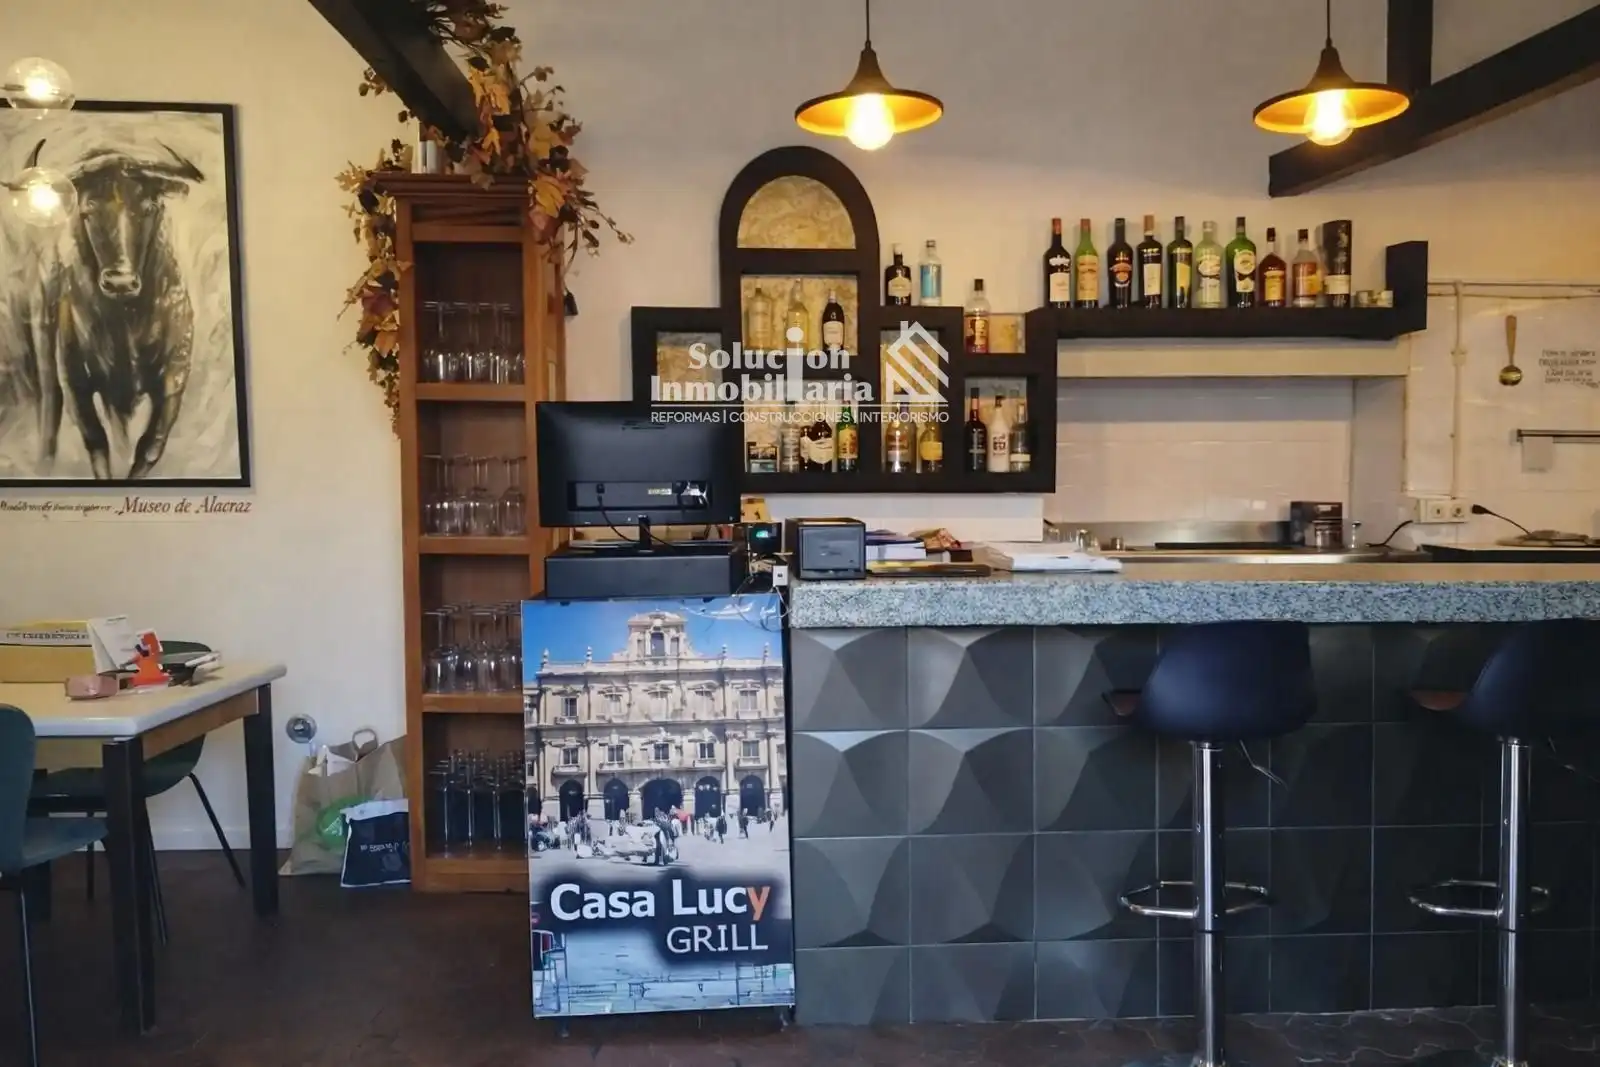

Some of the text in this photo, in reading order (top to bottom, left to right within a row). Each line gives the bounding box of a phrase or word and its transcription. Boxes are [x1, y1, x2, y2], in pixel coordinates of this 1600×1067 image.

[117, 496, 171, 515] Museo
[174, 498, 192, 513] de
[550, 879, 770, 920] Casa Lucy
[666, 924, 768, 953] GRILL
